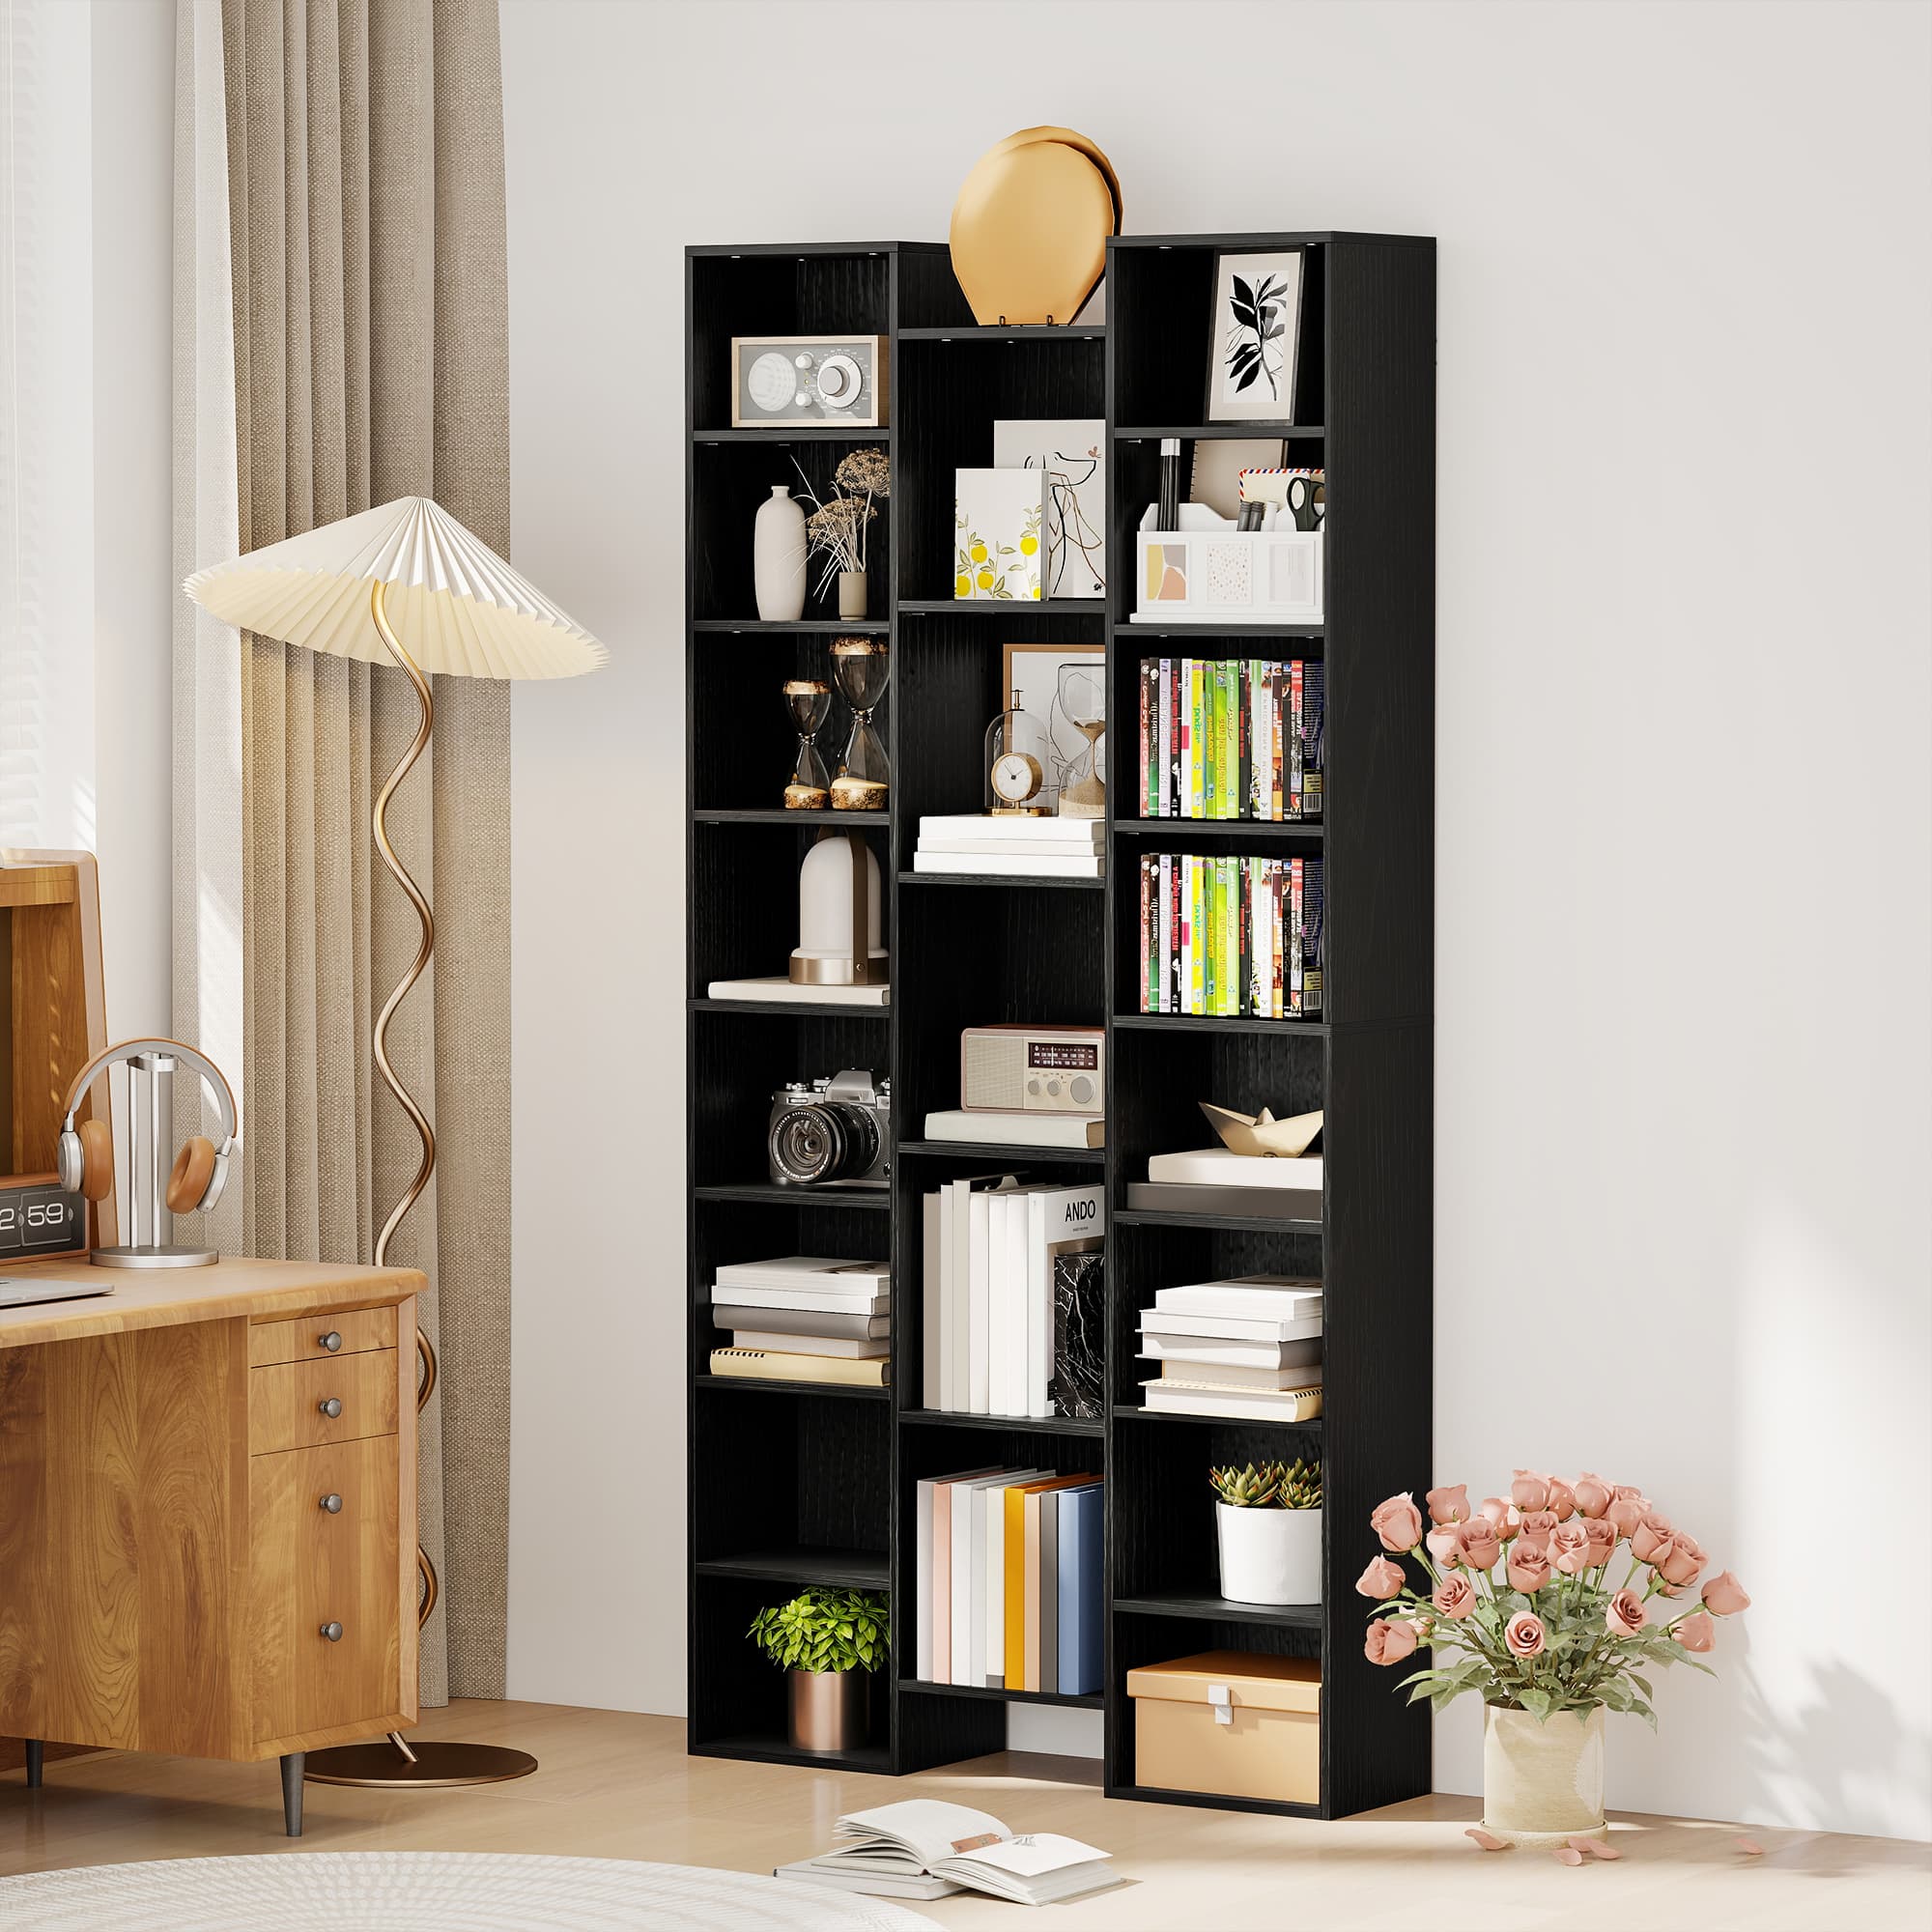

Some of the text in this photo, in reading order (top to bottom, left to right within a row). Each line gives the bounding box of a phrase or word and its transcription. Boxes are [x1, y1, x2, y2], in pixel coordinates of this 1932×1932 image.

[0, 1203, 64, 1230] 2 59
[1065, 1199, 1096, 1222] ANDO
